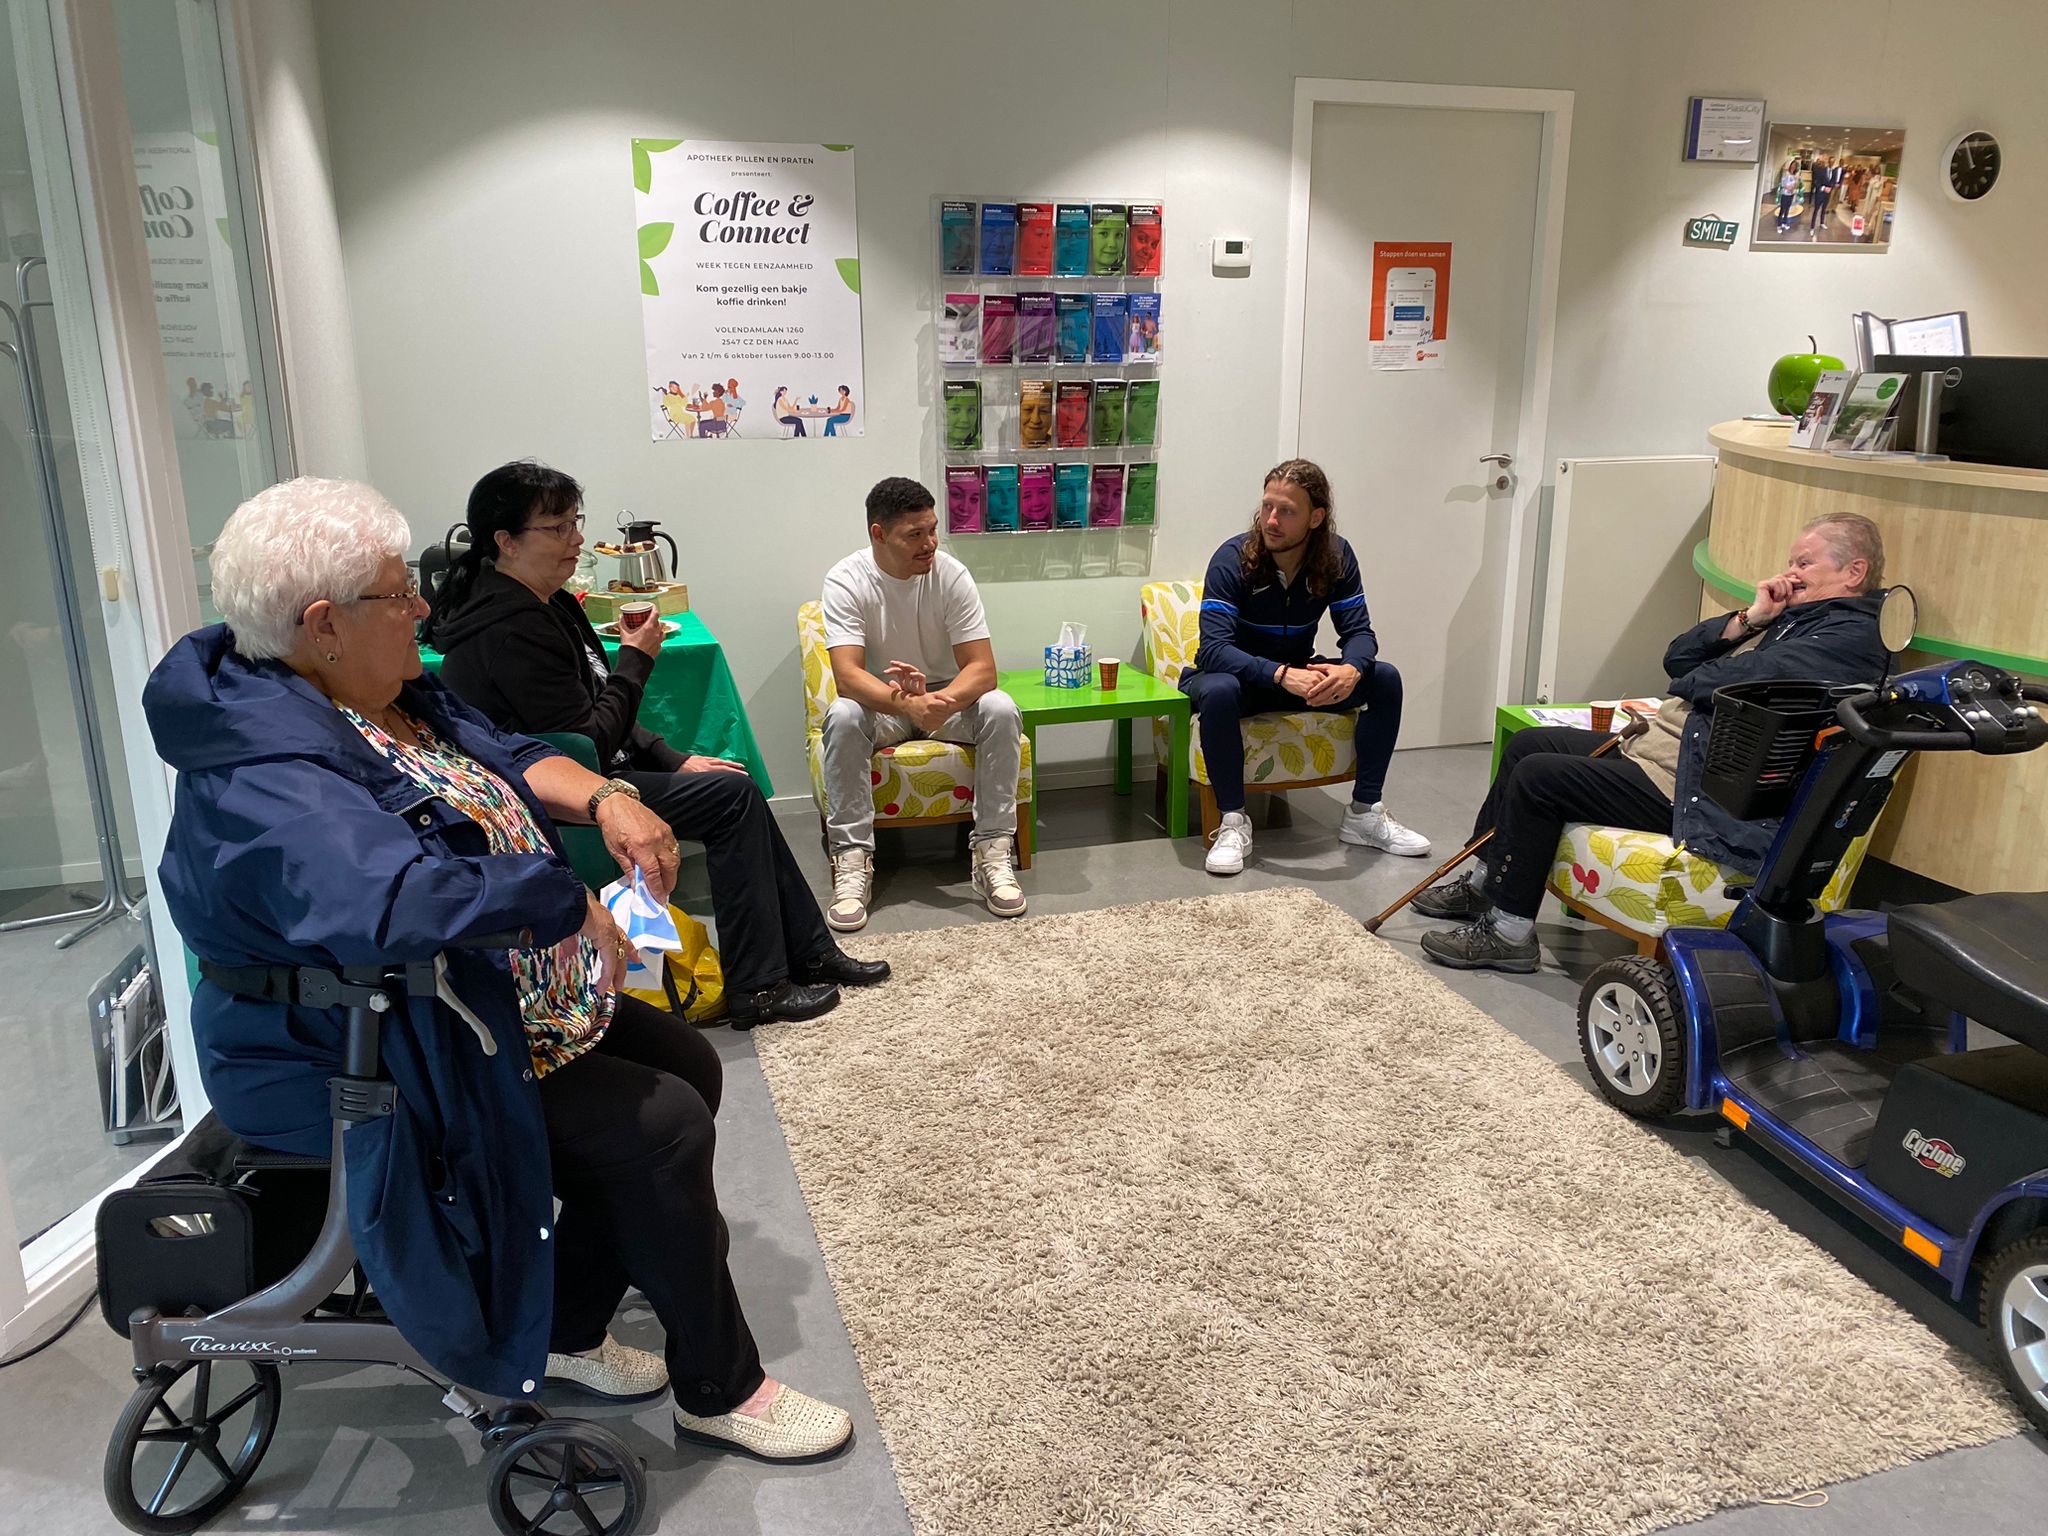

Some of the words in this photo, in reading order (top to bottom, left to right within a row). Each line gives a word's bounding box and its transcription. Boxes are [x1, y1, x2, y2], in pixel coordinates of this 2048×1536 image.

[693, 190, 780, 221] Coffee
[788, 194, 814, 216] &
[699, 220, 810, 244] Connect
[1690, 221, 1736, 242] SMILE
[721, 284, 759, 295] gezellig
[781, 284, 808, 295] bakje
[716, 298, 744, 306] koffie
[747, 298, 787, 306] drinken!
[1905, 1132, 1964, 1172] Cyclone
[1936, 1164, 1954, 1178] 22
[180, 1336, 277, 1352] Travixx
